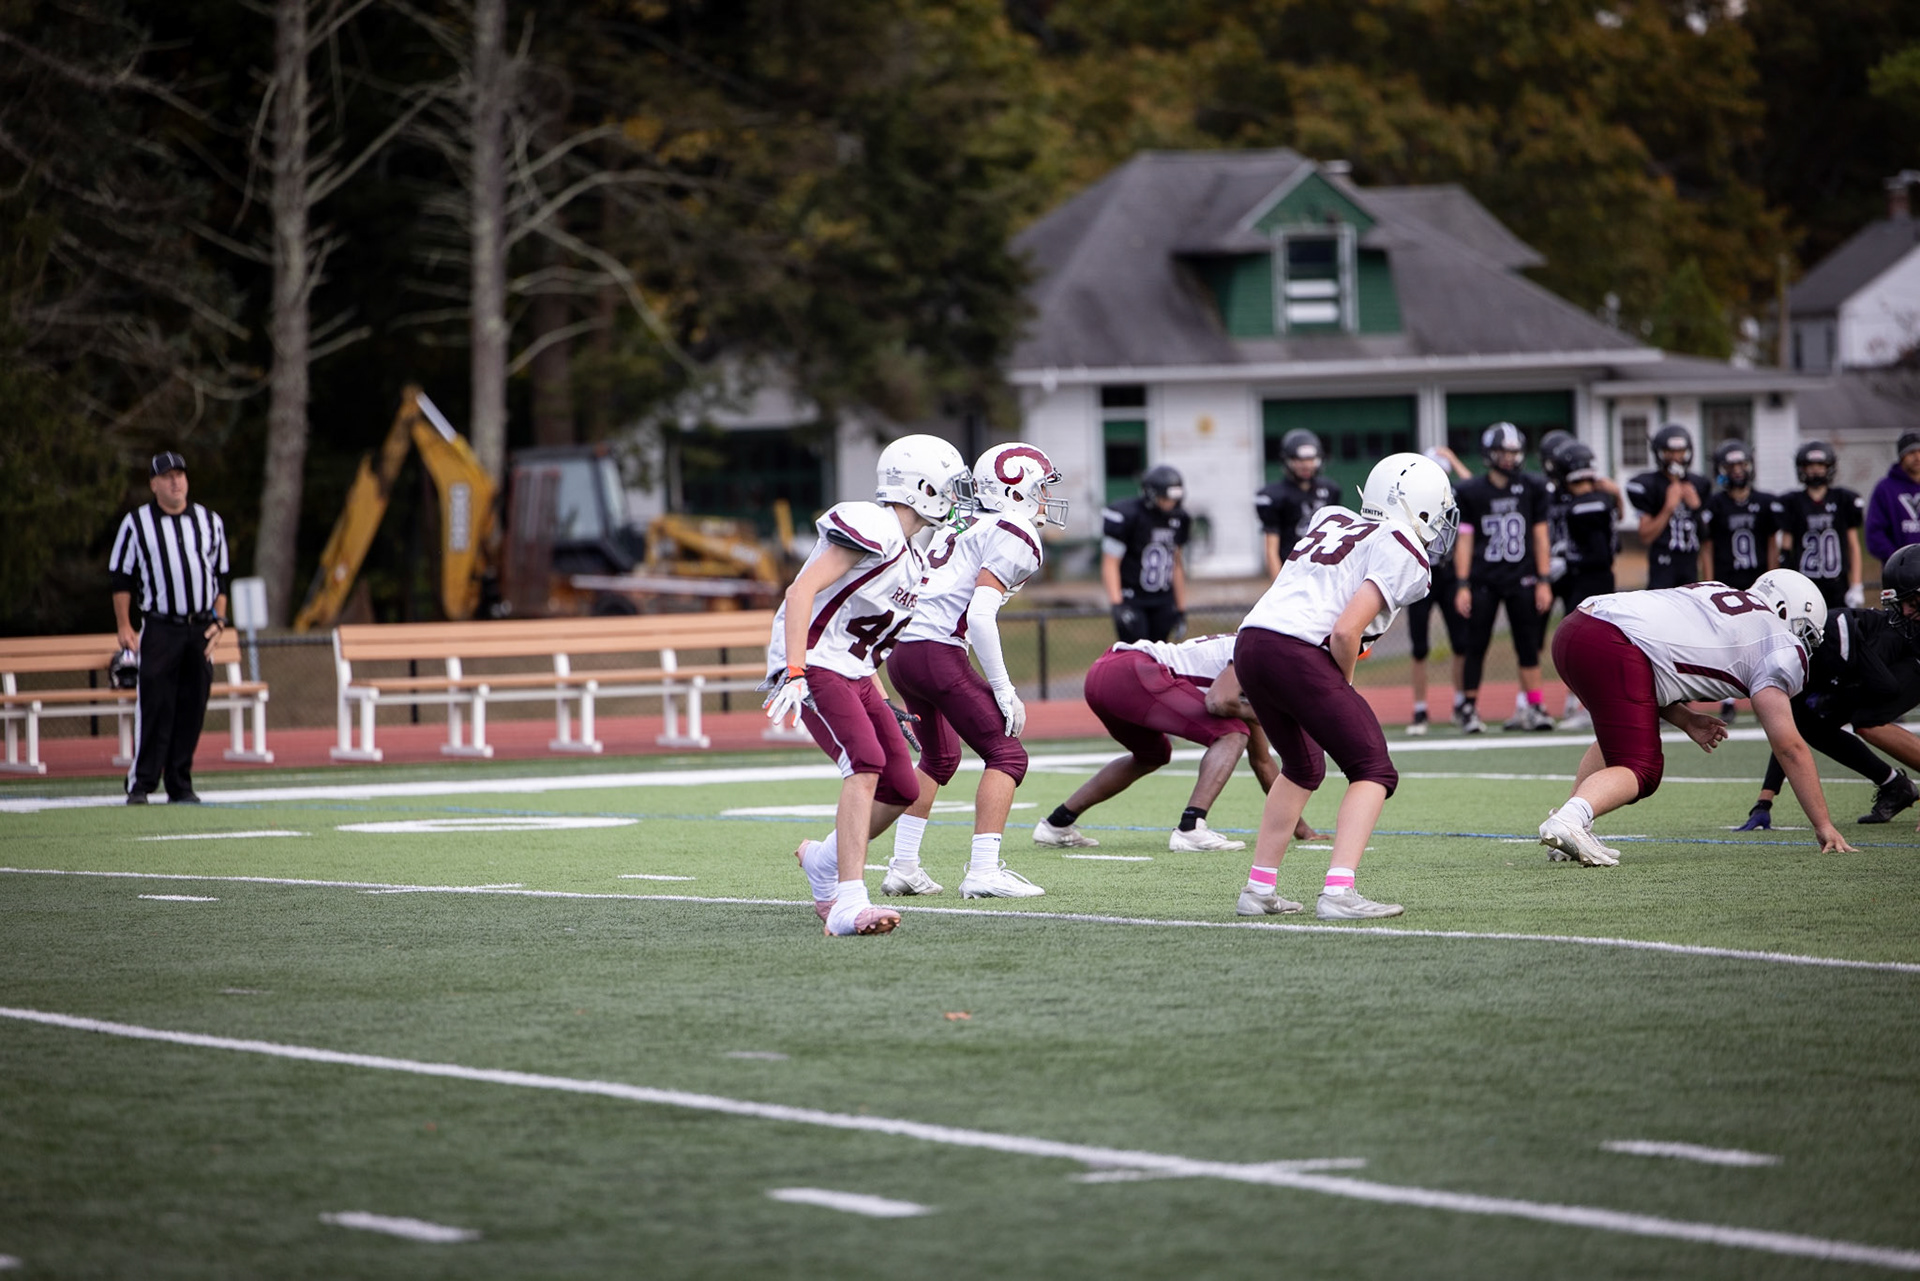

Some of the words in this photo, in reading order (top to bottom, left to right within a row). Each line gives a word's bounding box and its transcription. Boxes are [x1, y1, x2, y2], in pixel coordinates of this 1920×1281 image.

[1287, 513, 1380, 566] 53
[1731, 527, 1758, 570] 9
[1799, 528, 1842, 578] 20
